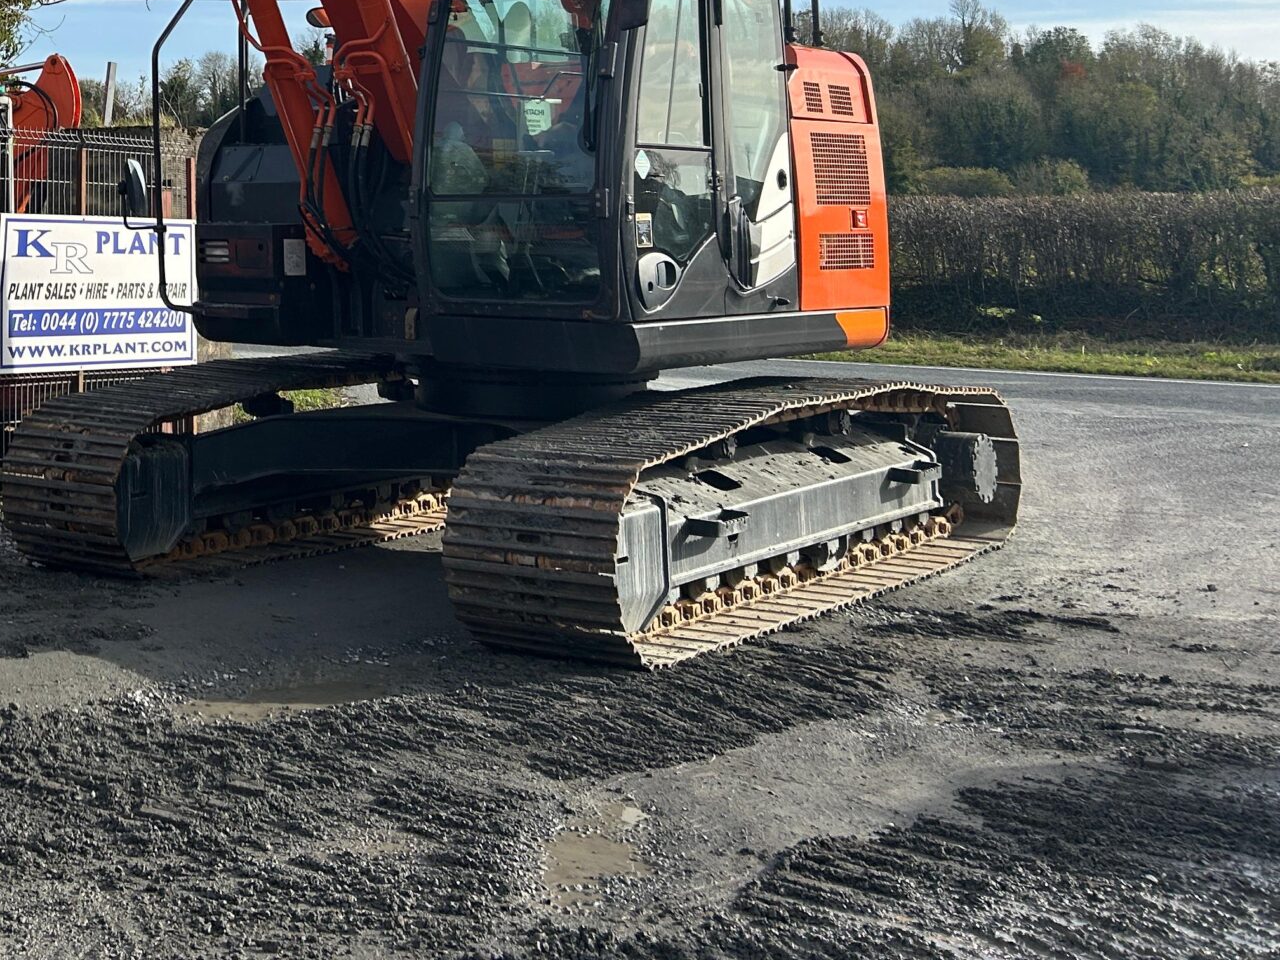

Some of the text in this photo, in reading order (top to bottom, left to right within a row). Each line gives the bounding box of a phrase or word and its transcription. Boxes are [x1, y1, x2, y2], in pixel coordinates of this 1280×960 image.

[11, 229, 186, 274] KR PLANT
[7, 282, 187, 301] PLANT SALES HIRE PARTS & PAIR
[12, 311, 184, 333] Tel: 0044 (0) 7775 424200
[7, 341, 187, 359] WWW.KRPLANT.COM
